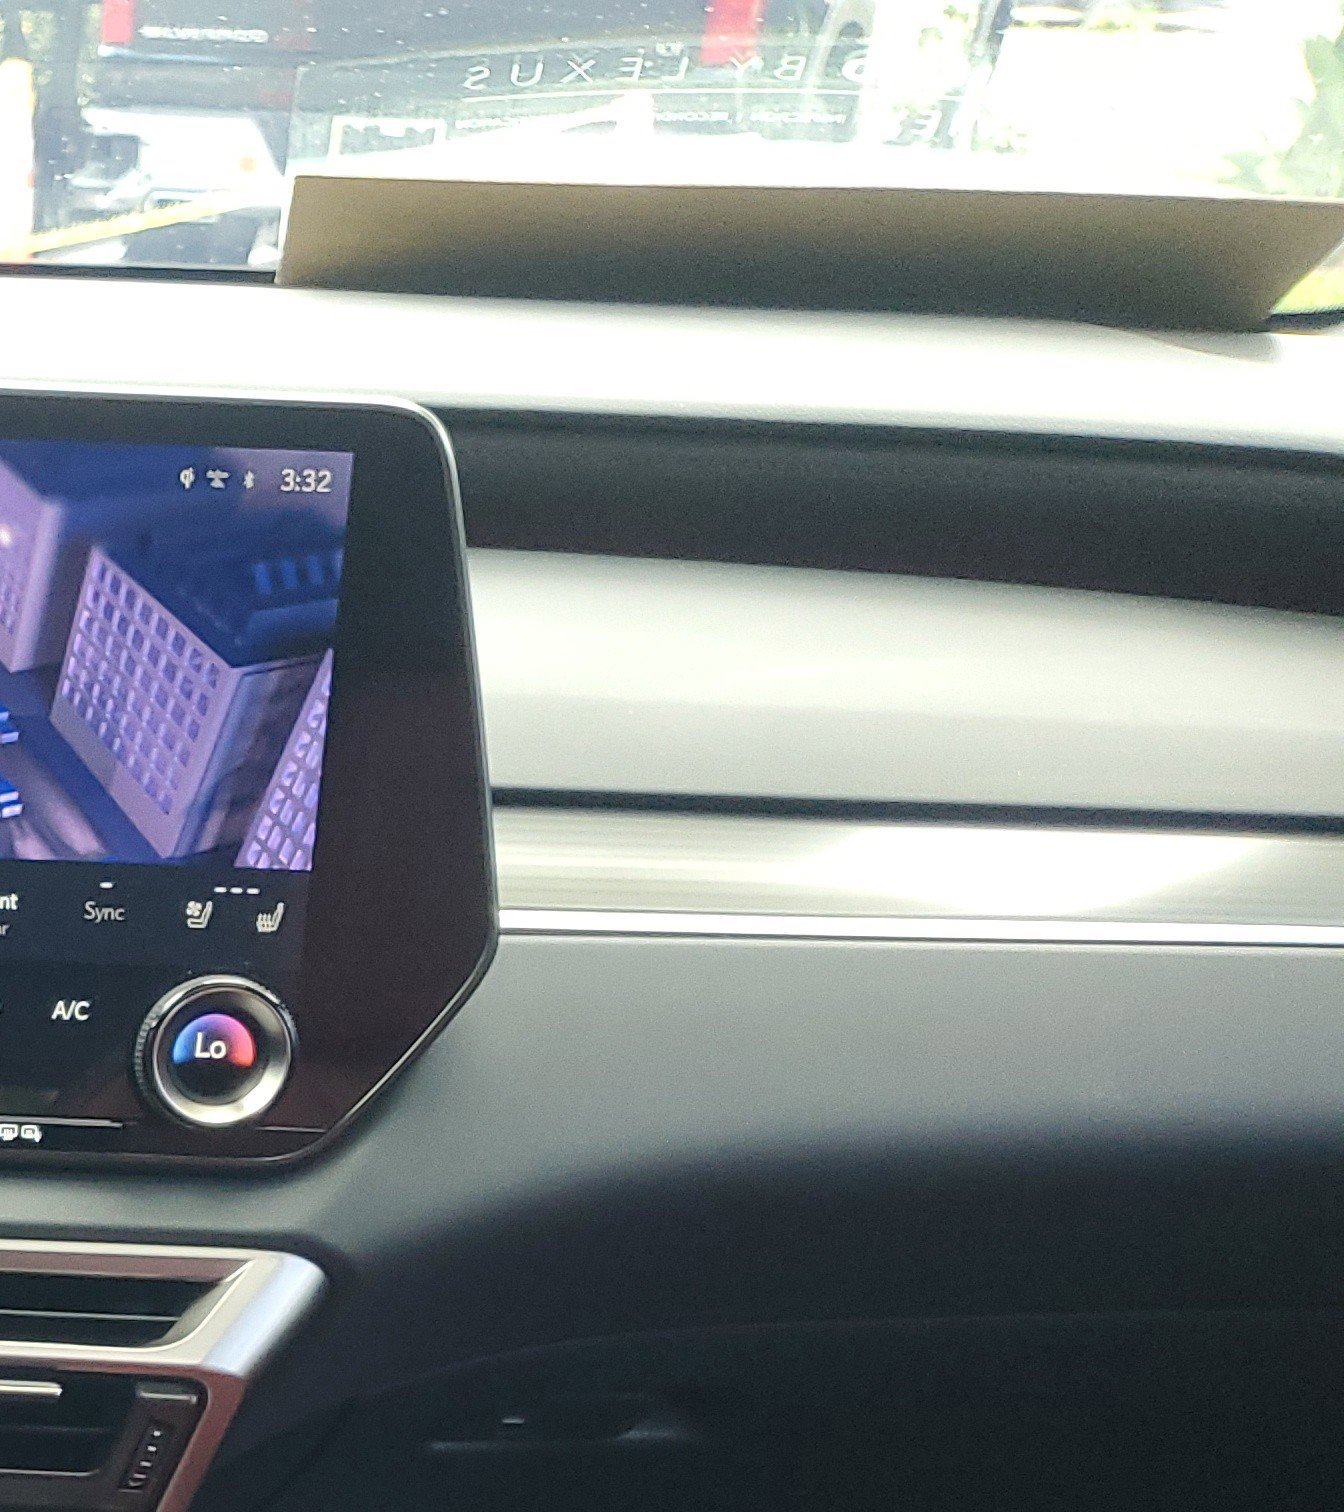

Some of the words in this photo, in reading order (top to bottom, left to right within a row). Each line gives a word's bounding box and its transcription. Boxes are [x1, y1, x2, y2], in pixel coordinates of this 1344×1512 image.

[280, 469, 332, 492] 3:32
[84, 900, 126, 923] Sync
[51, 1000, 90, 1021] A/C
[194, 1033, 227, 1060] Lo
